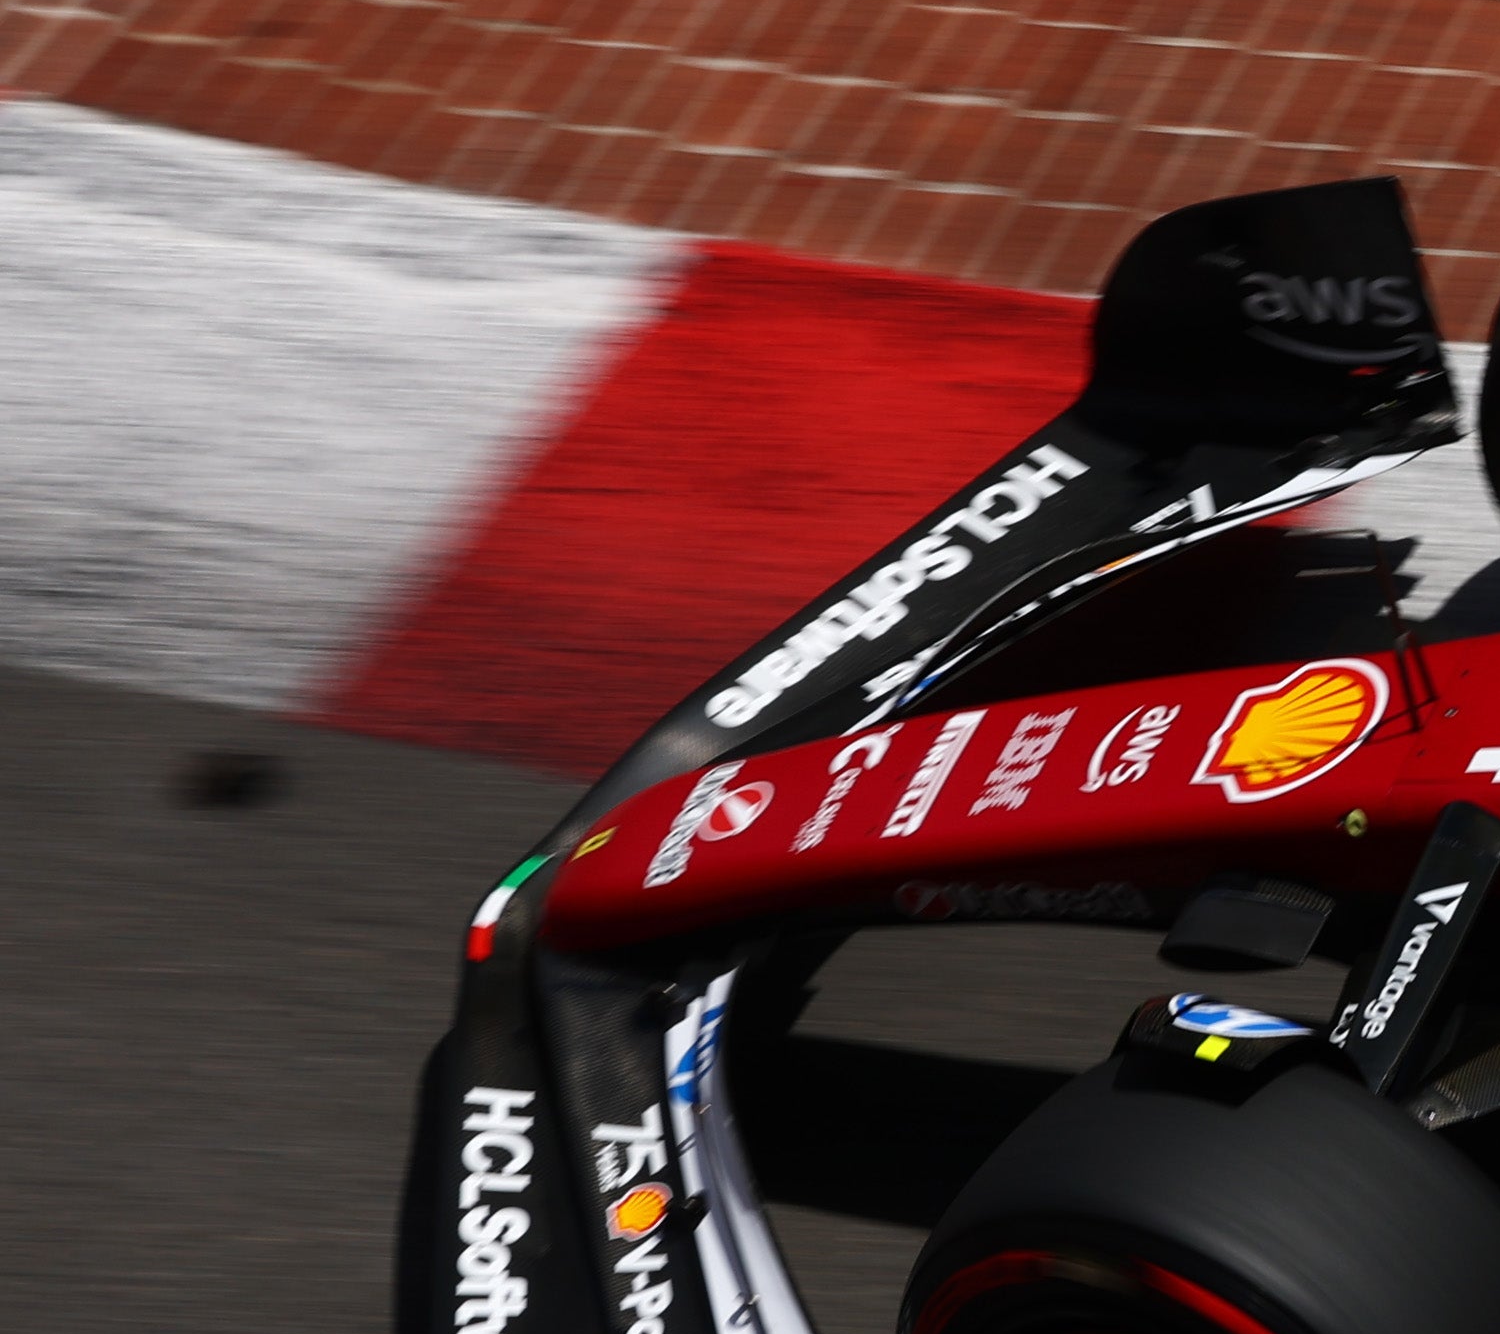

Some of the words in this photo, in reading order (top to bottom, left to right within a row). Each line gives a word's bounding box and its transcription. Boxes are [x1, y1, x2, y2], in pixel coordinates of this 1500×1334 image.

[1240, 270, 1420, 327] aws
[705, 444, 1091, 728] HCLSoftware
[1109, 704, 1181, 786] aws
[592, 1103, 668, 1180] 75
